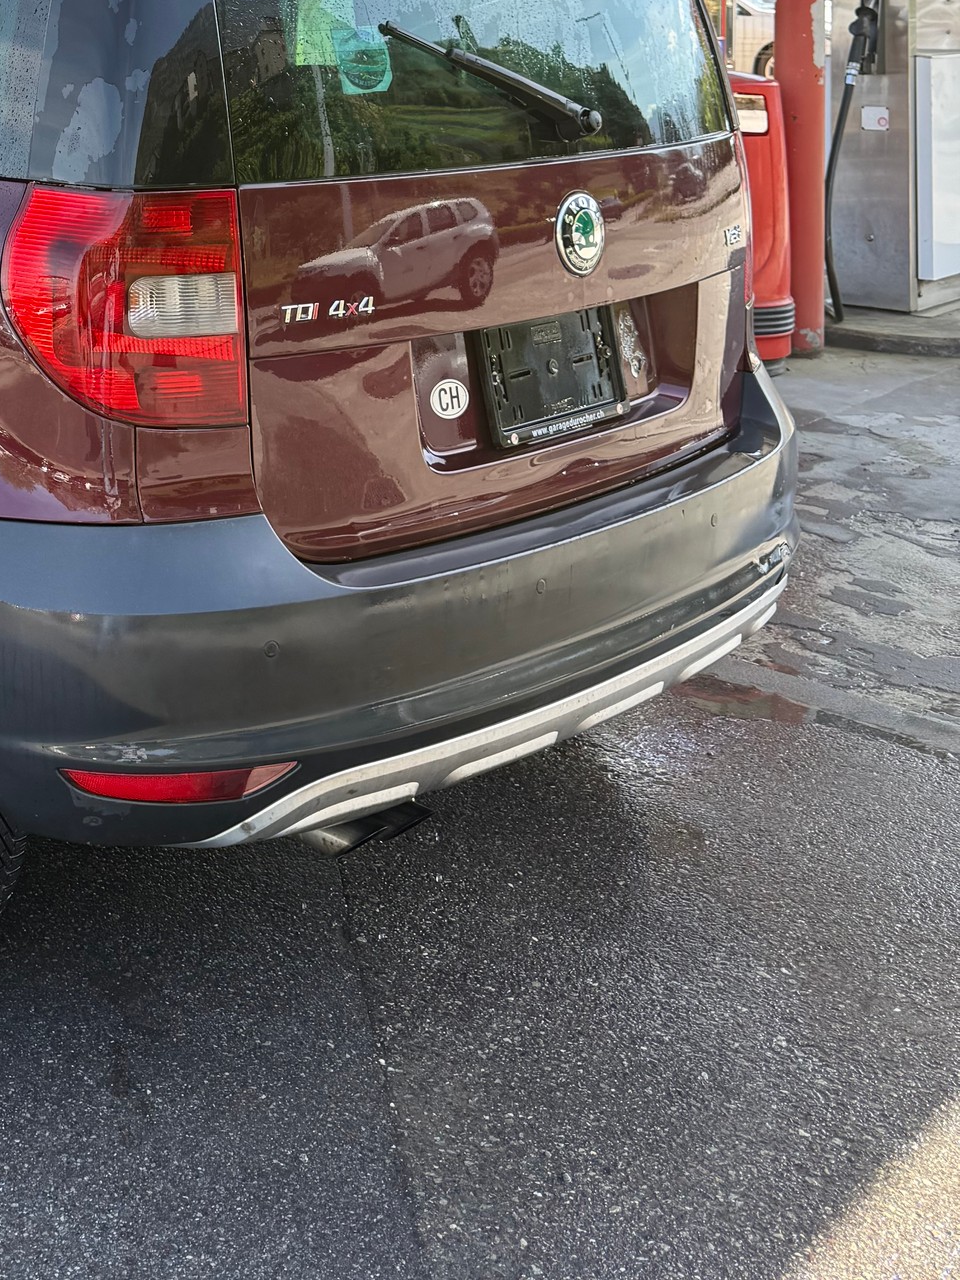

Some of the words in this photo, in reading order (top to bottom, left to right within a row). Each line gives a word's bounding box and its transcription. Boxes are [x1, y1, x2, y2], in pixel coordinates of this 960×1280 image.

[281, 303, 320, 324] TDI
[328, 296, 376, 318] 4x4
[437, 385, 461, 412] CH
[531, 410, 605, 438] www.garagedurocher.ch
